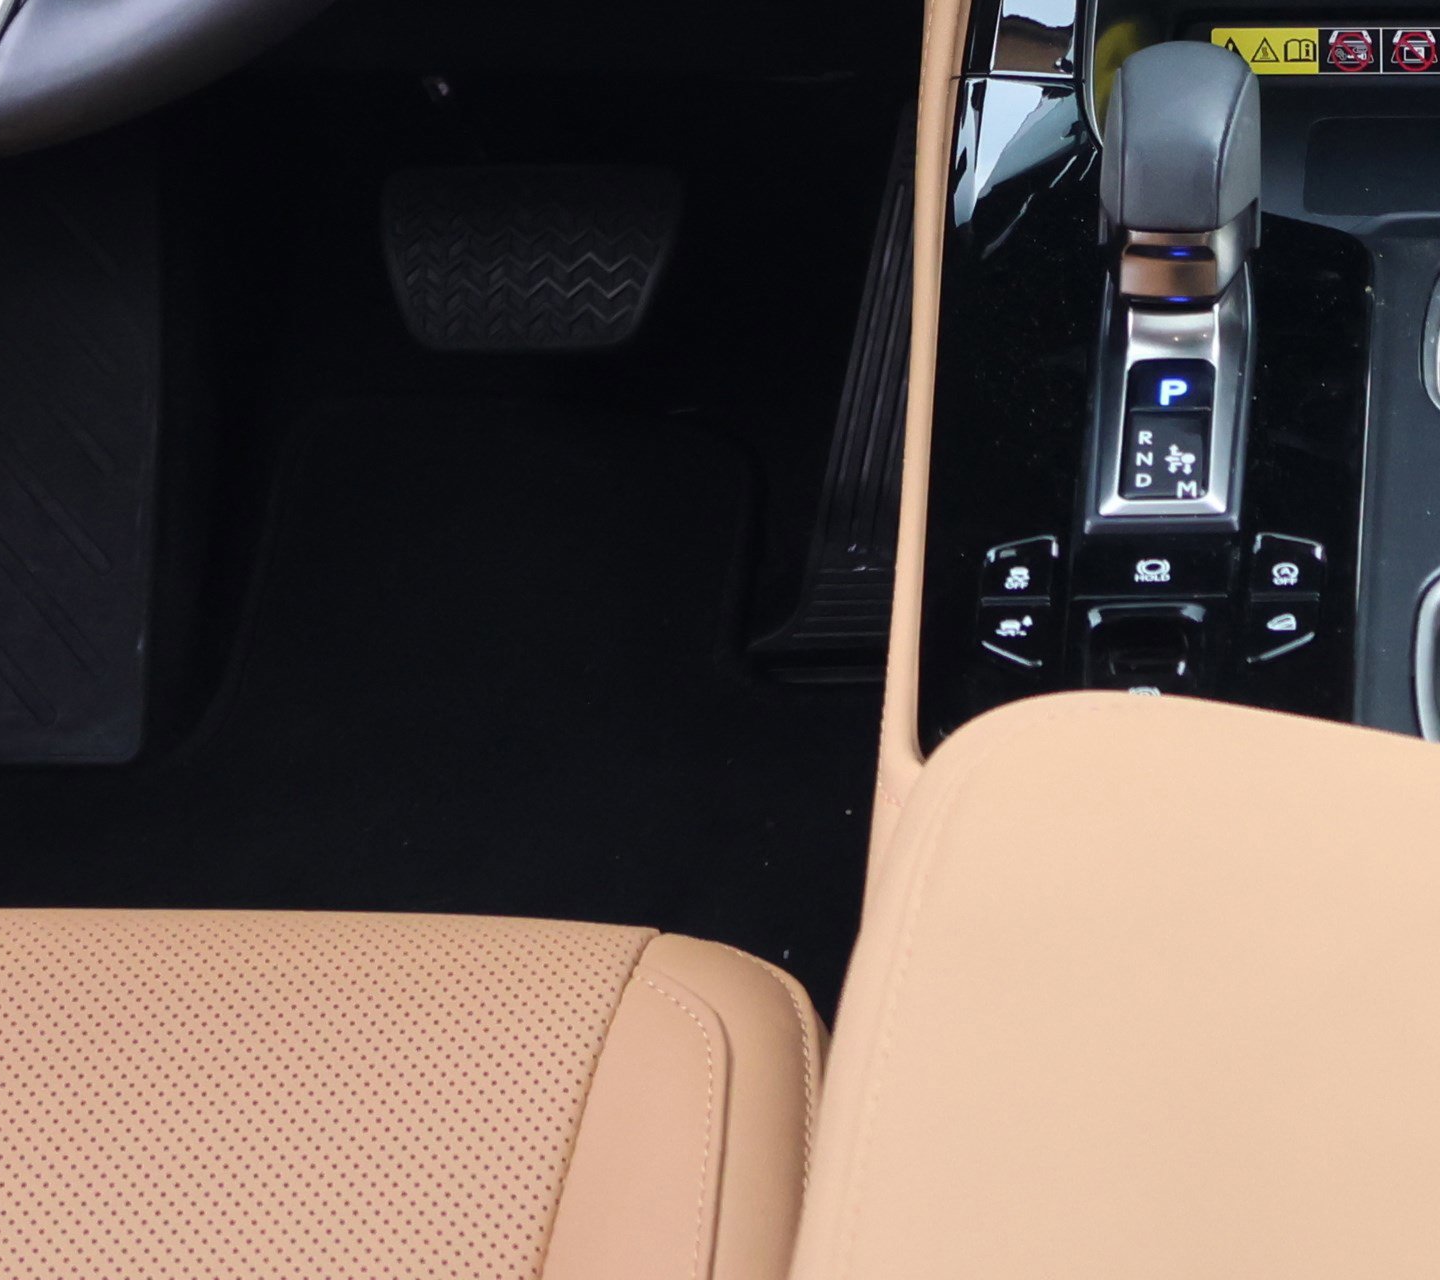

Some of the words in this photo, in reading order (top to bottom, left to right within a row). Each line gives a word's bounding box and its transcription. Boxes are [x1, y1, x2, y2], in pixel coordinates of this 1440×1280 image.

[1160, 379, 1187, 405] P
[1138, 431, 1153, 445] R
[1136, 453, 1153, 466] N
[1135, 474, 1152, 488] D
[1177, 481, 1198, 498] M
[1134, 573, 1171, 582] HOLD
[1272, 577, 1298, 586] OFF
